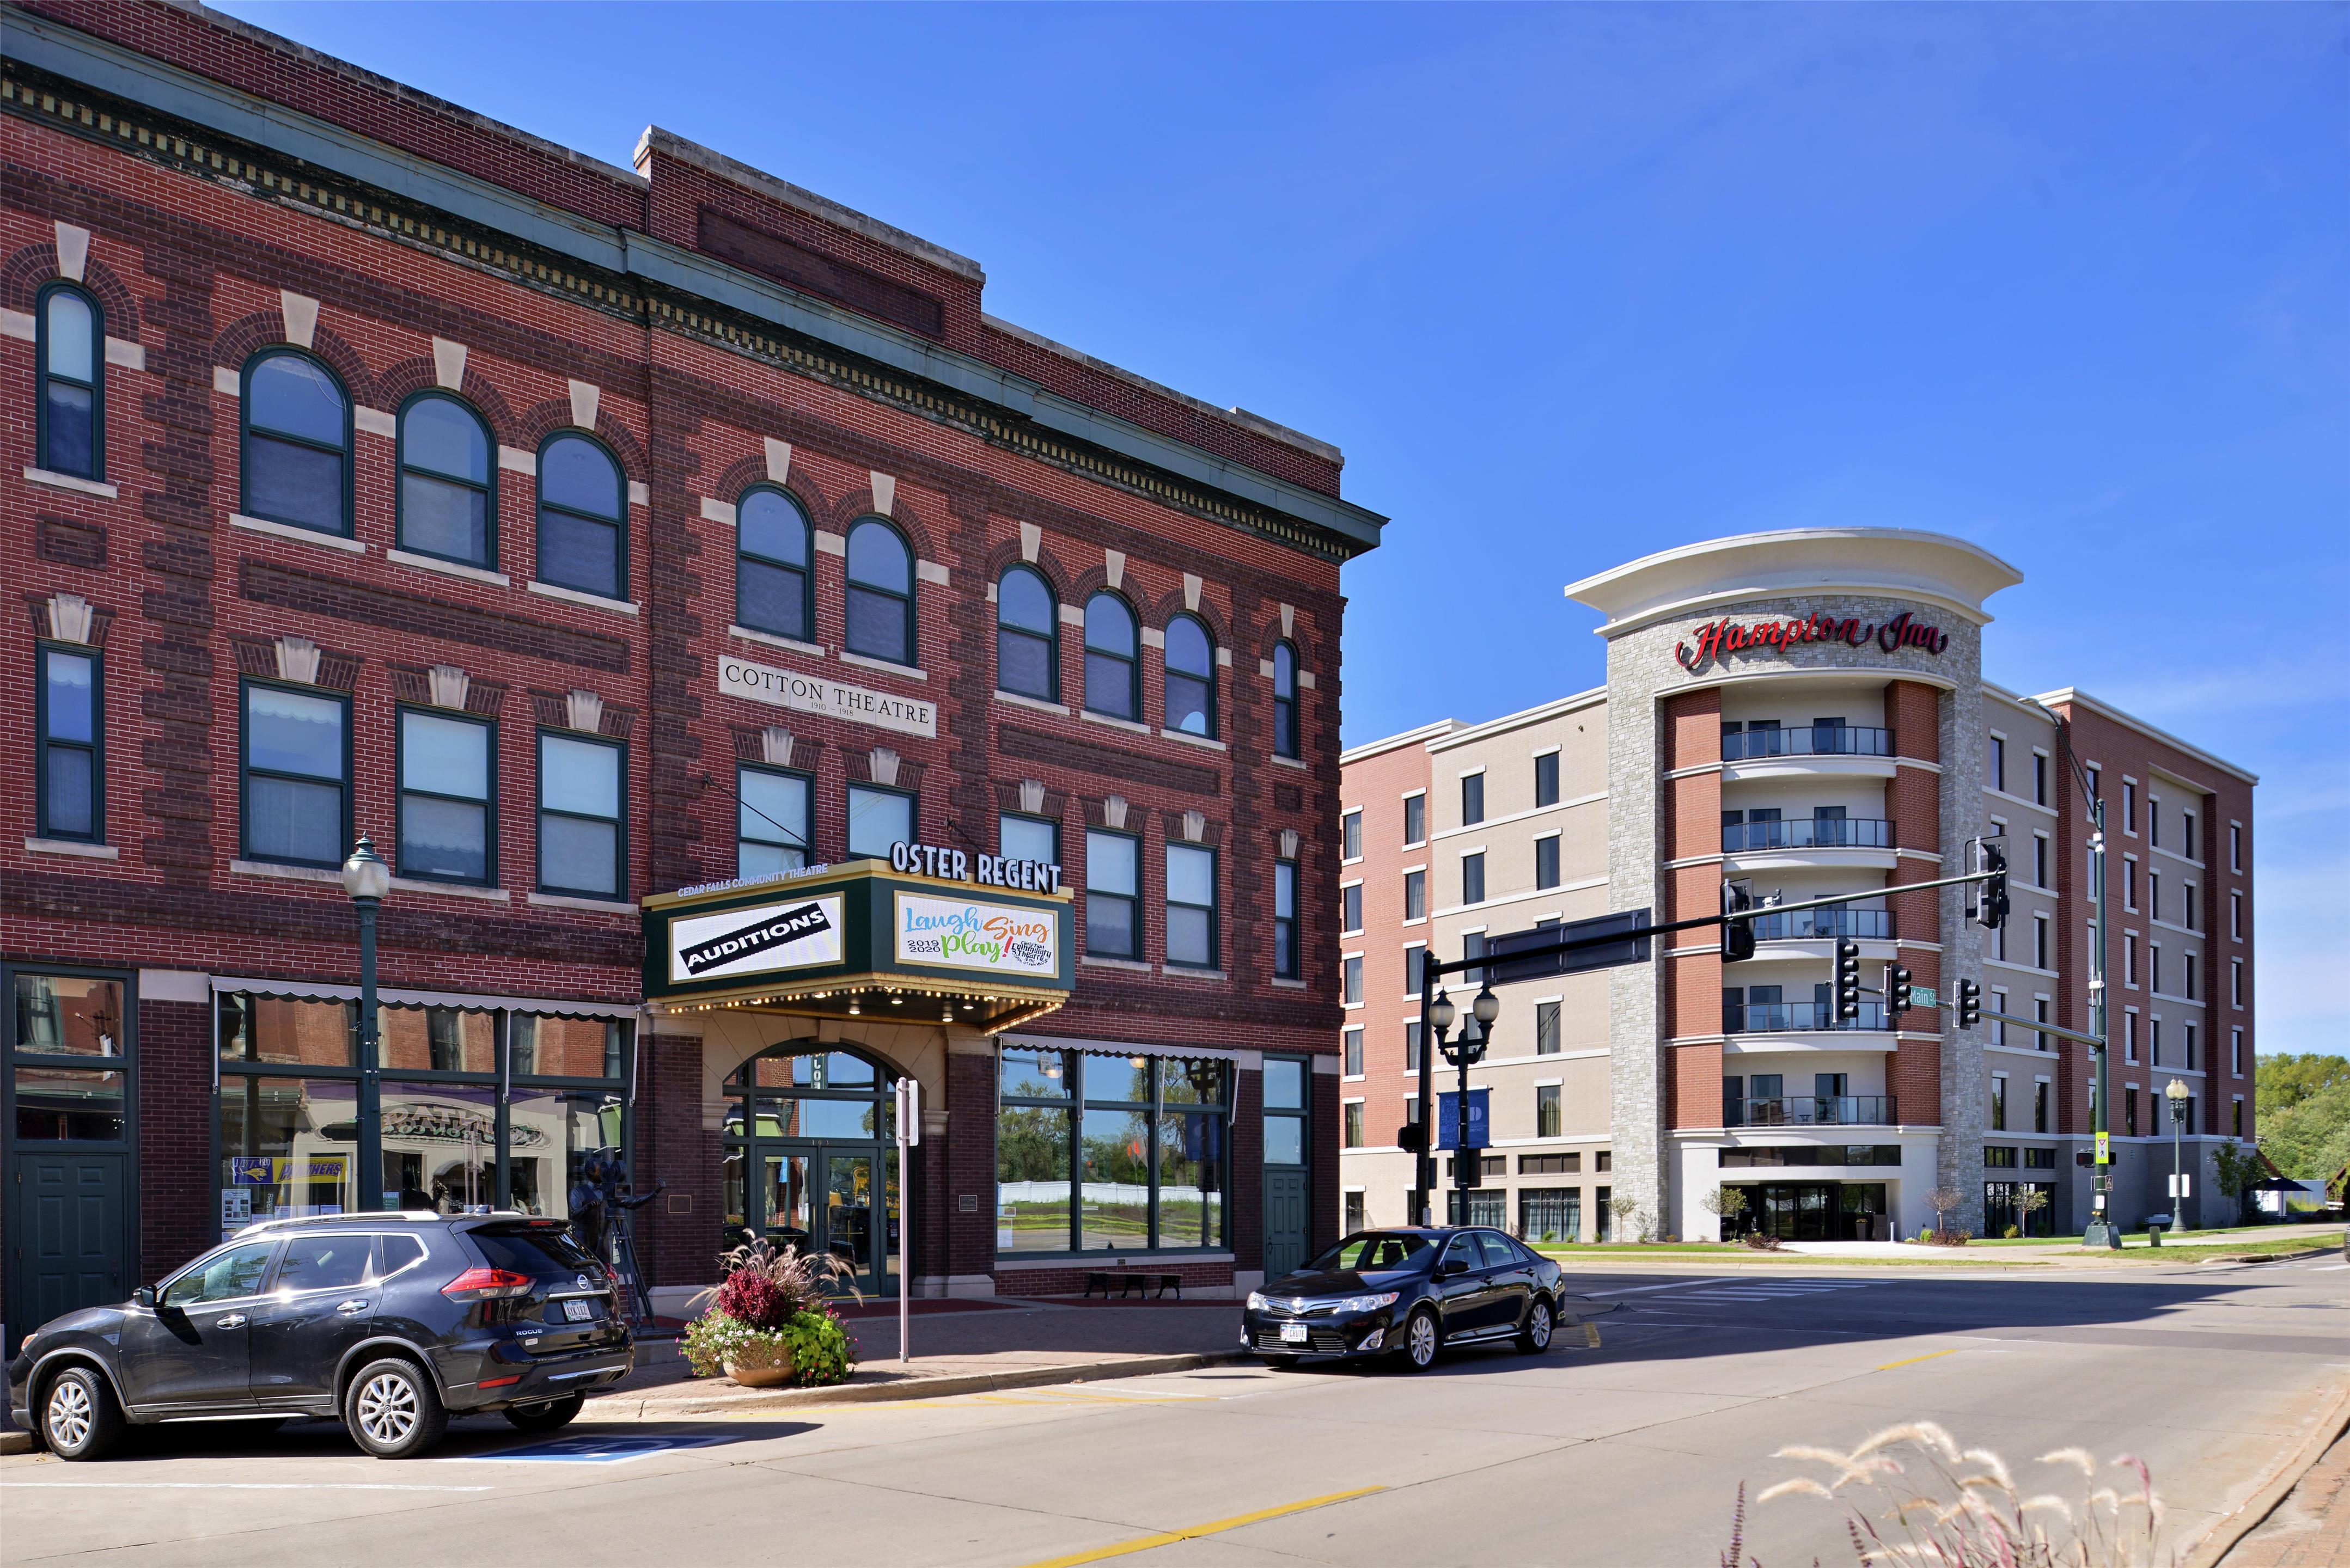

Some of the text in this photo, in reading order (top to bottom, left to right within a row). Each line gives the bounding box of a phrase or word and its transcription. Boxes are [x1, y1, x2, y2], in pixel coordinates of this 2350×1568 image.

[1675, 612, 1949, 670] Hampton Inn
[725, 664, 930, 724] COTTON THEATRE
[811, 702, 826, 711] 1910
[839, 707, 853, 716] 1918
[678, 863, 828, 897] CEDAR FALLS COMMUNITY THEATRE
[890, 841, 1061, 895] OSTER REGENT
[687, 910, 825, 967] AUDITIONS
[905, 906, 1049, 942] Laugh Sing
[941, 930, 1013, 963] Play!
[1911, 990, 1935, 1004] Main St
[577, 1306, 587, 1315] 182
[1289, 1330, 1305, 1338] CHUTE
